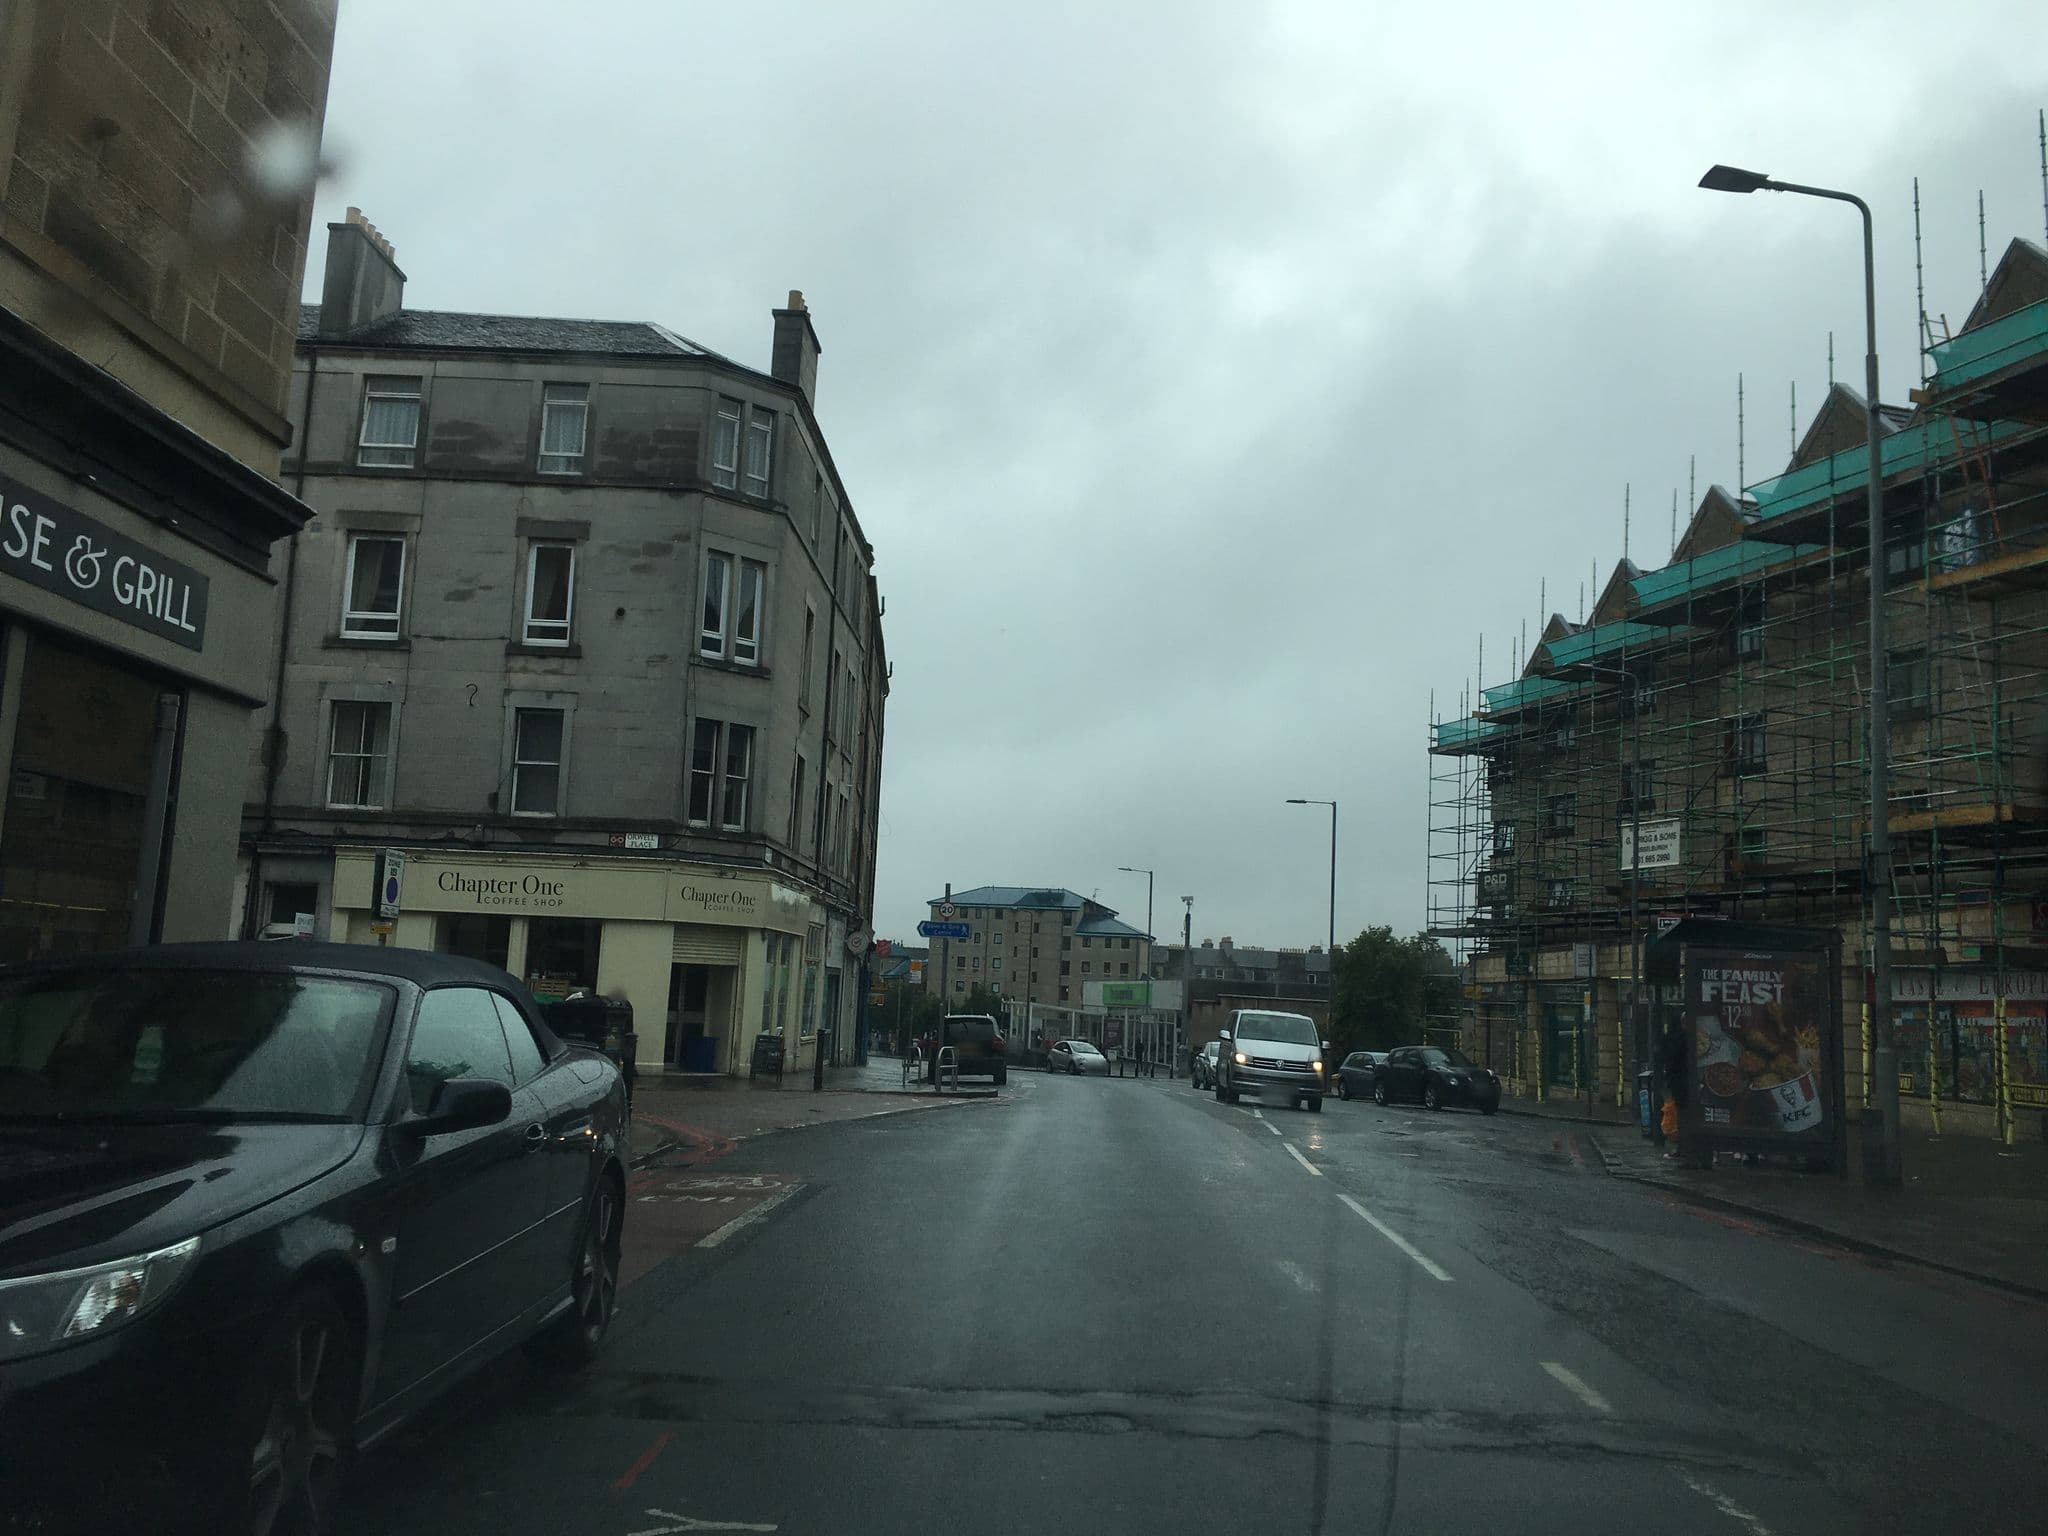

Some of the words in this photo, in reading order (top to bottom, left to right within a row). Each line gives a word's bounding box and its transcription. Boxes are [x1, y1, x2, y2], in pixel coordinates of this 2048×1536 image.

[0, 494, 56, 572] SE
[65, 535, 108, 589] &
[112, 555, 196, 633] GRILL
[627, 833, 655, 841] ORWELL
[388, 859, 401, 868] ZONE
[1484, 873, 1507, 886] P&D
[438, 871, 517, 904] Chapter
[522, 875, 564, 896] One
[484, 896, 528, 906] COFFEE
[534, 898, 564, 907] SHOP
[681, 886, 729, 909] Chapter
[731, 890, 756, 906] One
[708, 904, 733, 912] COFFEE
[737, 906, 755, 914] SHOP
[941, 906, 953, 914] 20
[1701, 969, 1720, 980] THE
[1721, 969, 1785, 982] FAMILY
[1701, 981, 1785, 1005] FEAST
[1782, 1105, 1811, 1123] KFC
